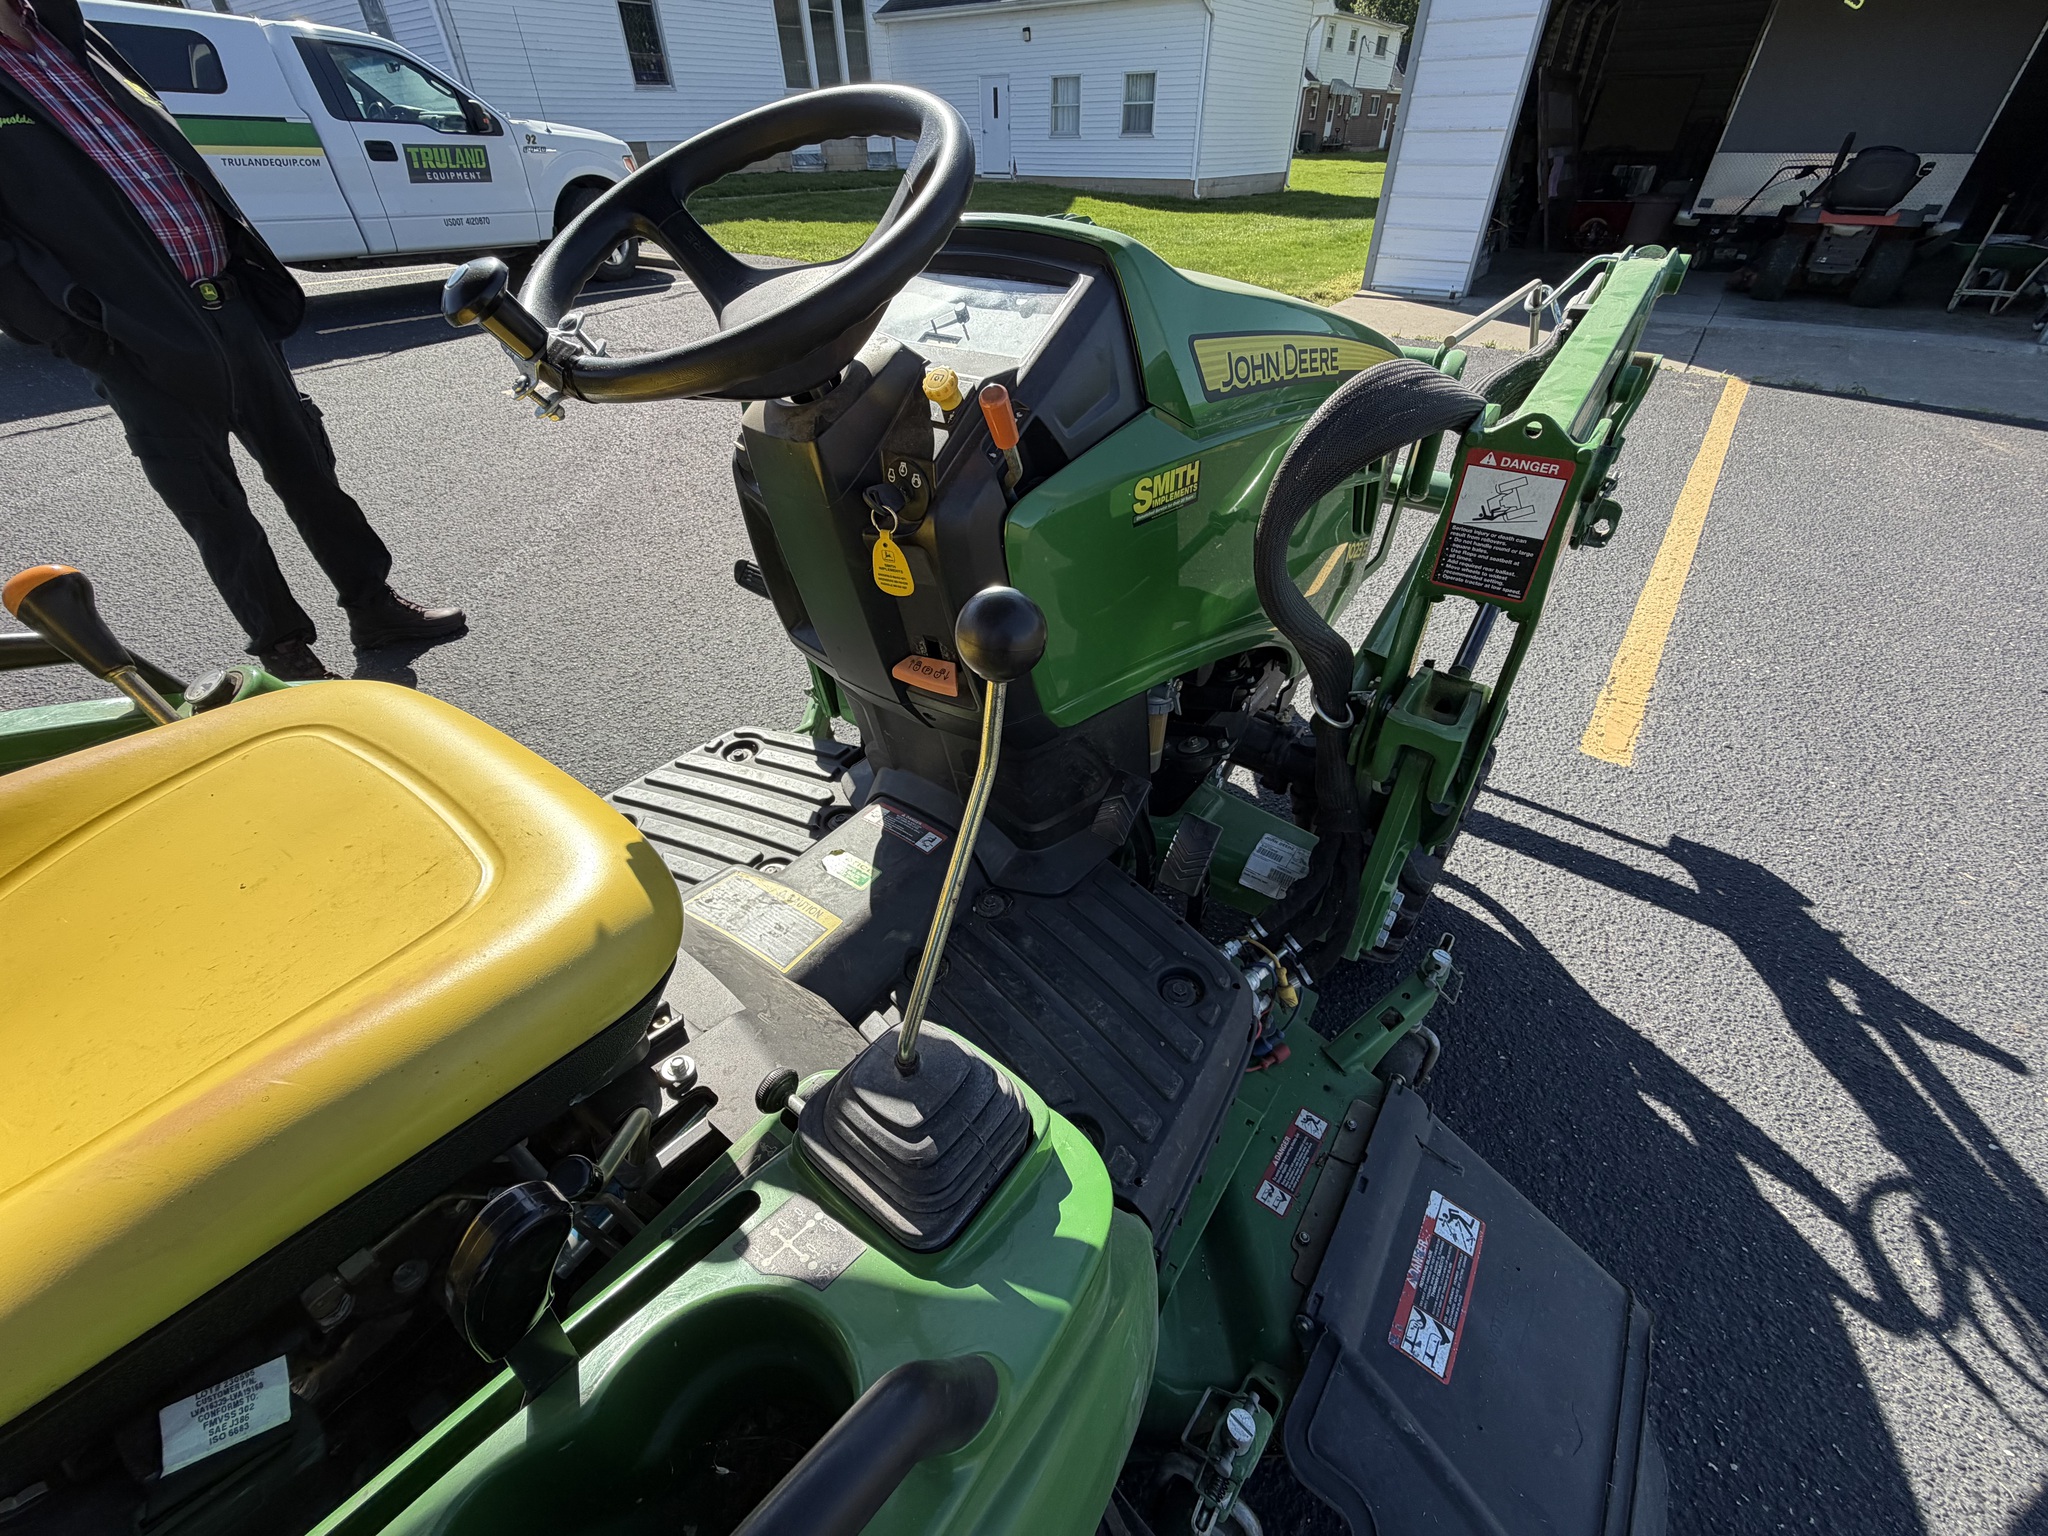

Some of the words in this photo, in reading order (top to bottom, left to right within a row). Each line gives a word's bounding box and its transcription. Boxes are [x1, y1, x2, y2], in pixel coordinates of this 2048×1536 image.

[525, 134, 537, 145] 92
[221, 158, 321, 168] TRULANDEQUIP.COM
[406, 147, 487, 169] TRULAND
[426, 171, 482, 180] EQUIPMENT
[443, 218, 464, 227] USDOT
[1222, 351, 1281, 388] JOHN
[1283, 343, 1340, 376] DEERE
[1500, 457, 1560, 475] DANGER
[1133, 460, 1200, 514] SMITH
[1152, 483, 1198, 508] IMPLEMENTS
[1274, 1135, 1291, 1161] DANGER
[195, 1382, 240, 1407] CUSTOMER
[197, 1397, 245, 1423] CONFORMS
[202, 1410, 237, 1430] FMVSS
[238, 1402, 255, 1416] 302
[208, 1421, 228, 1437] SAE
[208, 1432, 227, 1446] ISO
